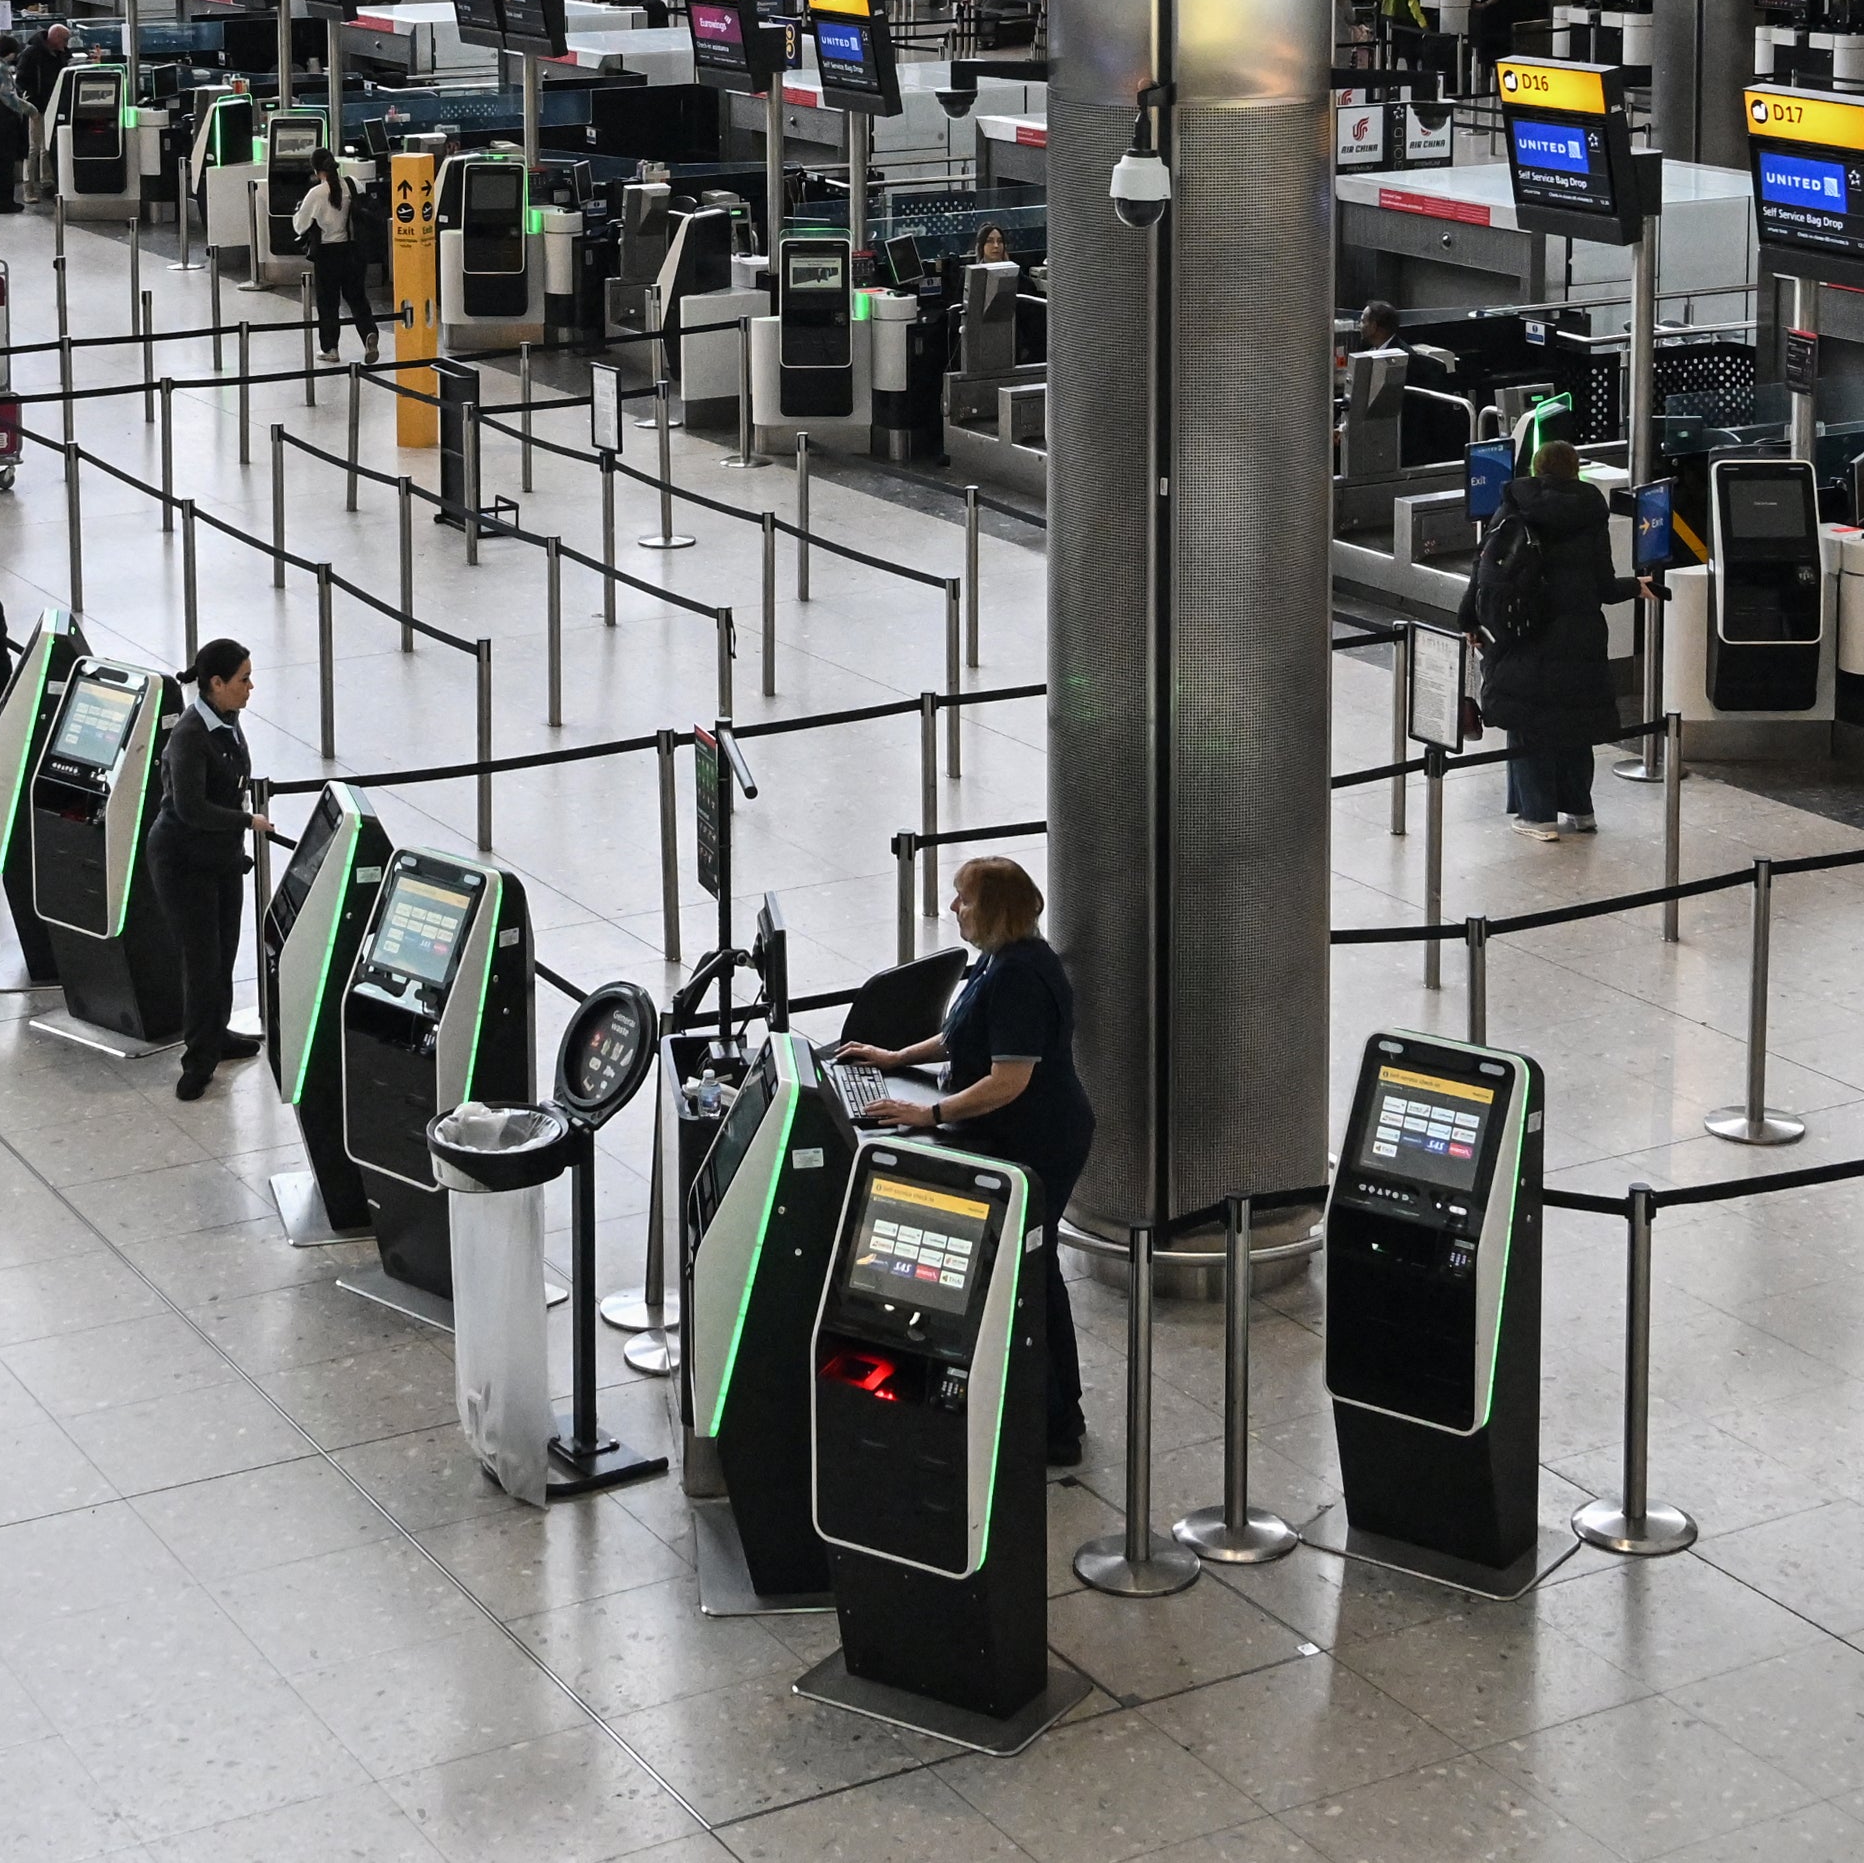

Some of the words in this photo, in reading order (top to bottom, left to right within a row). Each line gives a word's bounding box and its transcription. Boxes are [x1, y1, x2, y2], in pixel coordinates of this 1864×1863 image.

[700, 17, 726, 32] Eurowings
[821, 36, 849, 47] UNITED
[1522, 74, 1549, 91] D16
[1773, 104, 1803, 123] D17
[1341, 145, 1354, 154] AIR
[1355, 144, 1378, 153] CHINA
[1410, 141, 1422, 149] AIR
[1424, 139, 1445, 148] CHINA
[1519, 139, 1566, 154] UNITED
[1518, 170, 1530, 180] Self
[1532, 173, 1554, 184] Service
[1556, 176, 1569, 188] Bag
[1570, 178, 1587, 189] Drop
[1766, 172, 1821, 191] UNITED
[1763, 206, 1777, 217] Self
[1779, 209, 1805, 222] Service
[1806, 214, 1821, 226] Bag
[1824, 217, 1843, 230] Drop
[398, 227, 415, 235] Exit
[1471, 476, 1486, 486] Exit
[1651, 518, 1663, 528] Exit
[611, 1023, 629, 1036] waste
[1427, 1140, 1444, 1151] SAS
[894, 1262, 912, 1273] SAS
